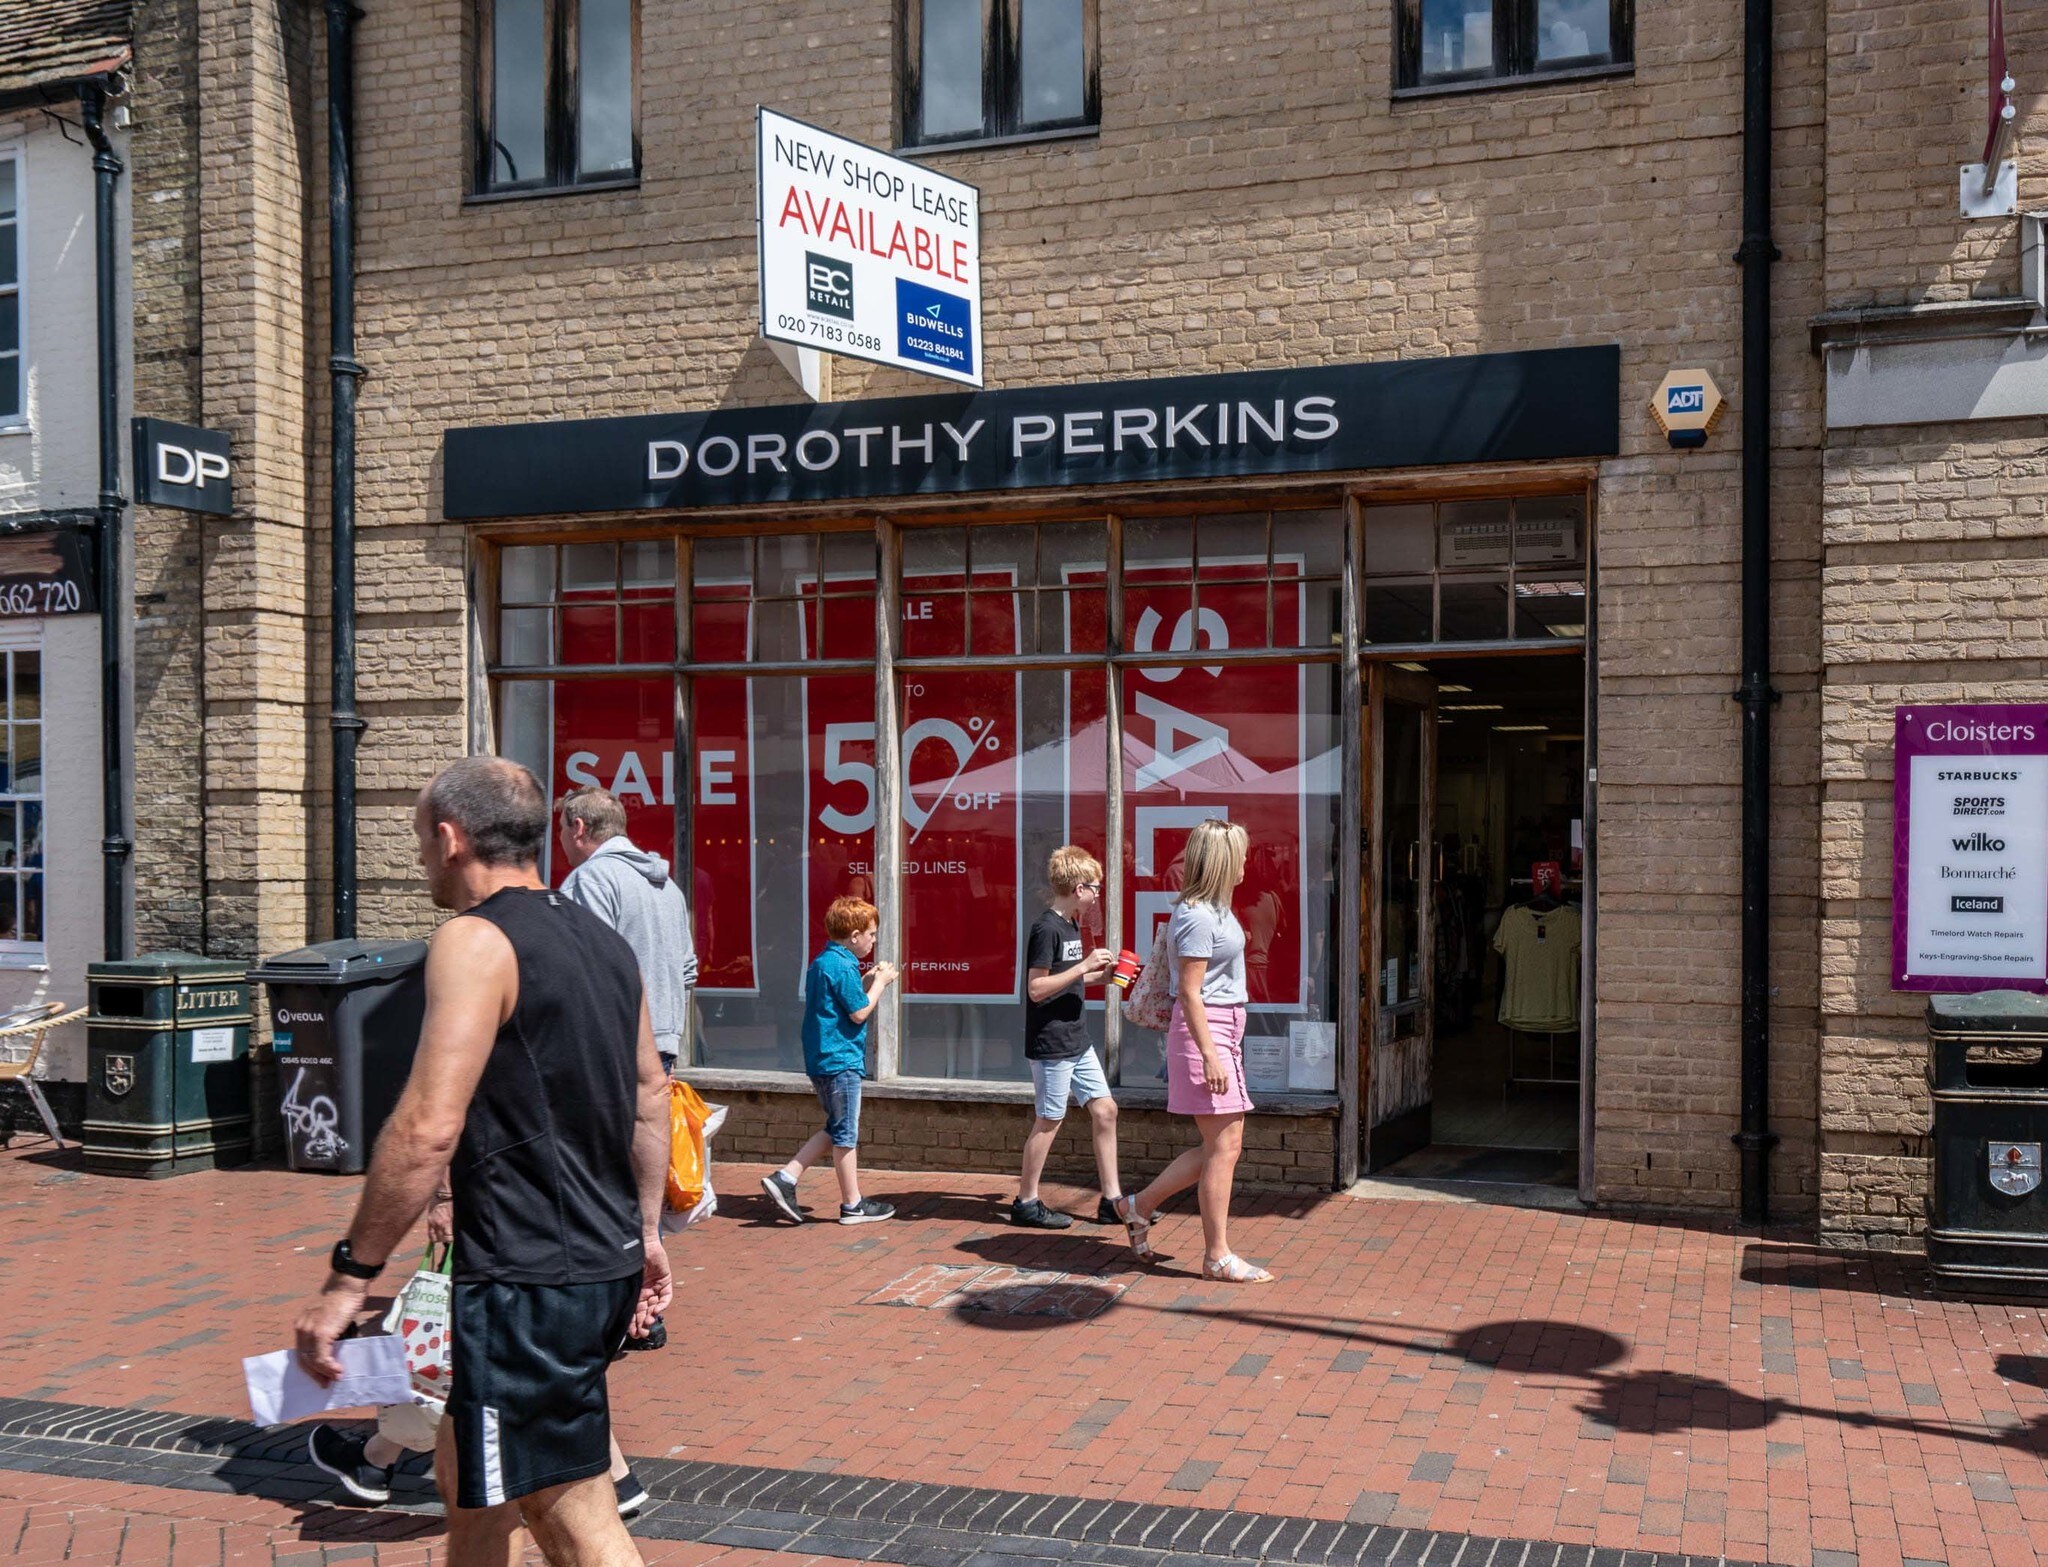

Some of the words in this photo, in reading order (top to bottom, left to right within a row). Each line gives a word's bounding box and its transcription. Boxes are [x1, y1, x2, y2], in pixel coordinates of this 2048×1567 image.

[775, 134, 835, 178] NEW
[843, 158, 904, 202] SHOP
[911, 182, 969, 228] LEASE
[779, 185, 969, 284] AVAILABLE
[809, 263, 850, 296] BC
[809, 290, 851, 309] RETAIL
[778, 314, 805, 333] 020
[810, 321, 843, 342] 7183
[848, 331, 881, 351] 0588
[907, 312, 964, 338] BIDWELLS
[907, 336, 934, 352] 01223
[935, 344, 964, 360] 841841
[1668, 391, 1704, 409] ADT
[648, 419, 985, 480] DOROTHY
[1012, 396, 1340, 458] PERKINS
[157, 442, 230, 488] DP
[38, 579, 81, 612] 720
[905, 684, 925, 697] TO
[1926, 719, 2035, 742] Cloisters
[954, 792, 1001, 810] OFF
[1953, 797, 2006, 807] SPORTS
[1951, 832, 2006, 851] wilko
[924, 860, 967, 875] LINES
[1941, 866, 2016, 880] Bonmarché
[1956, 898, 1999, 910] Iceland
[1930, 929, 1965, 937] Timelord
[1967, 929, 1992, 938] Watch
[1994, 931, 2024, 939] Repairs
[911, 962, 970, 971] PERKINS
[1919, 952, 2002, 962] Keys-Engraving-Shoe
[2004, 954, 2034, 963] Repairs
[177, 990, 239, 1010] LITTER
[290, 1012, 324, 1021] VEOLIA
